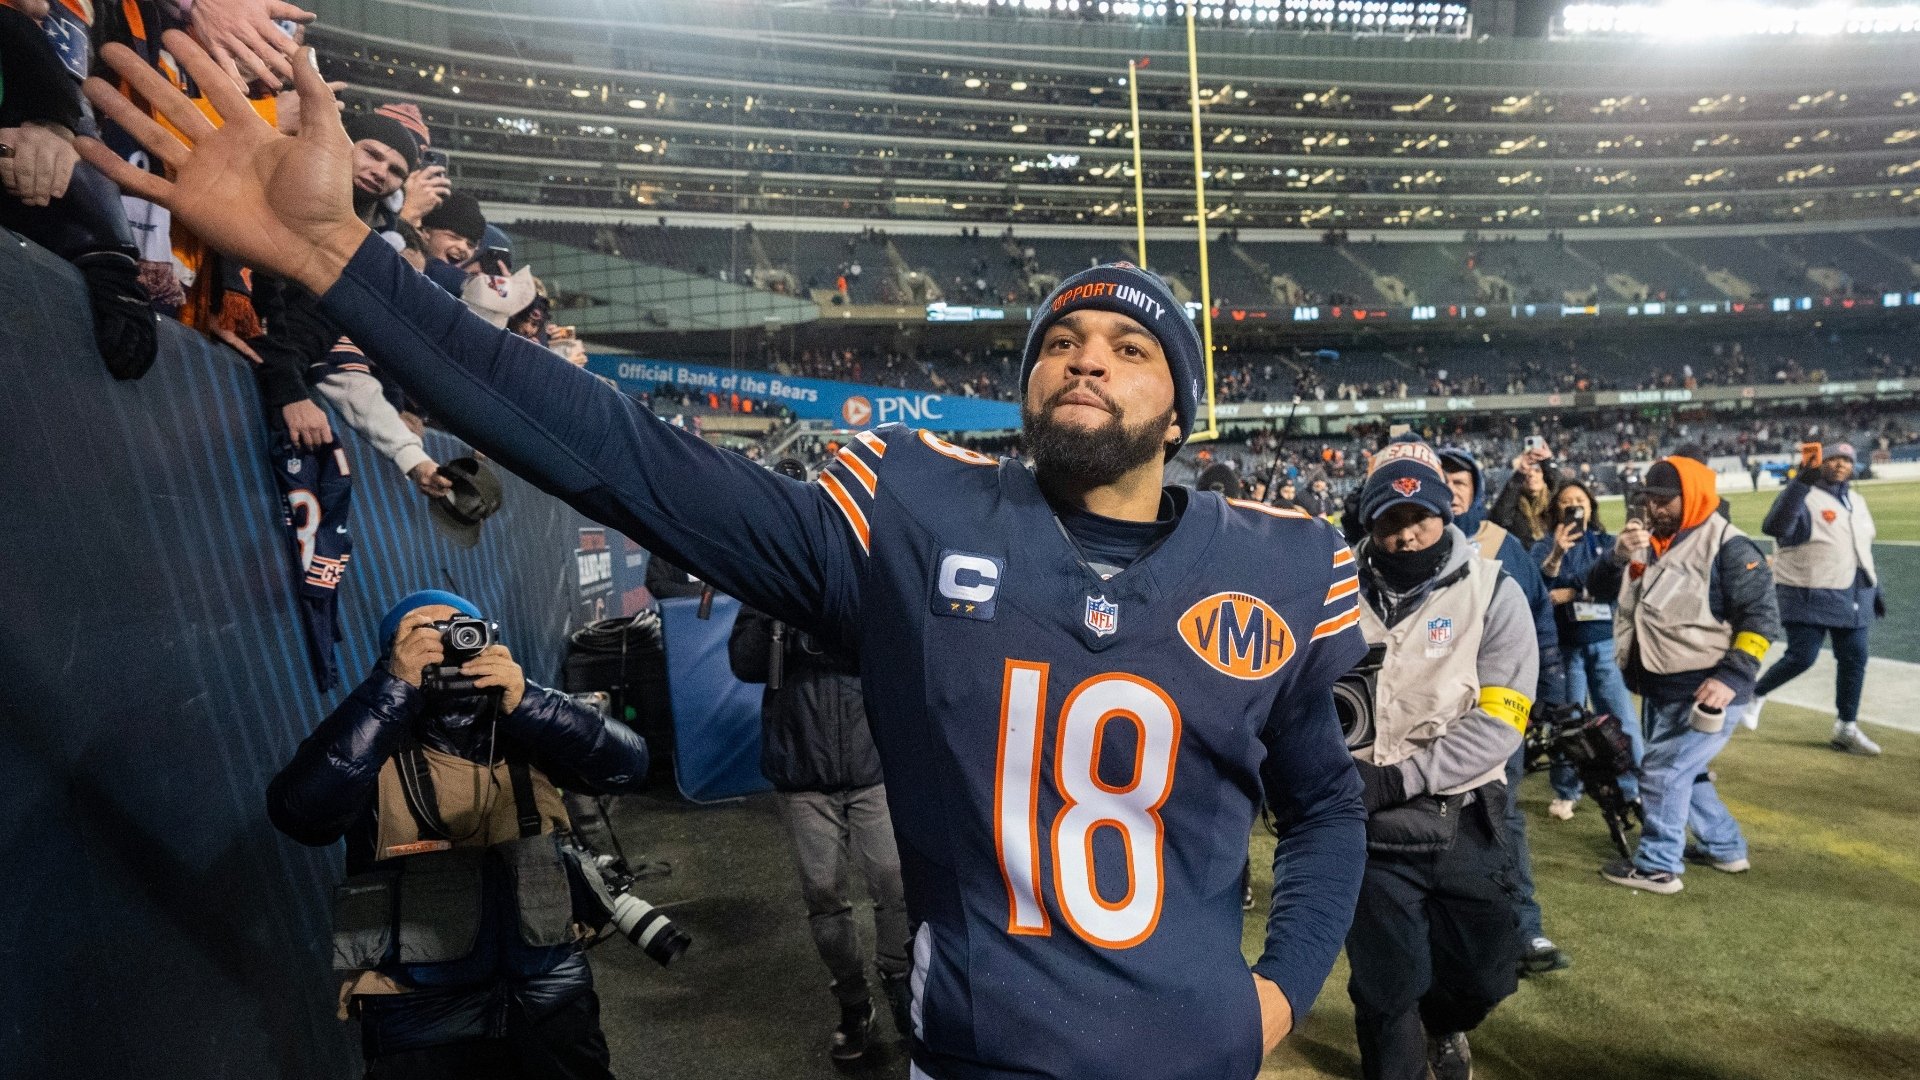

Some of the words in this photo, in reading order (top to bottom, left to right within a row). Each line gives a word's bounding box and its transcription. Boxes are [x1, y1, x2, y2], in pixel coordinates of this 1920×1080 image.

[617, 362, 673, 383] Official
[677, 368, 718, 388] Bank
[721, 374, 739, 390] of
[740, 377, 767, 394] the
[769, 380, 819, 403] Bears
[875, 393, 944, 422] PNC
[938, 554, 999, 603] C
[1090, 610, 1113, 629] NFL
[1195, 599, 1286, 673] VMH
[1430, 628, 1450, 641] NFL
[1503, 696, 1525, 714] WEEK
[993, 656, 1183, 950] 18
